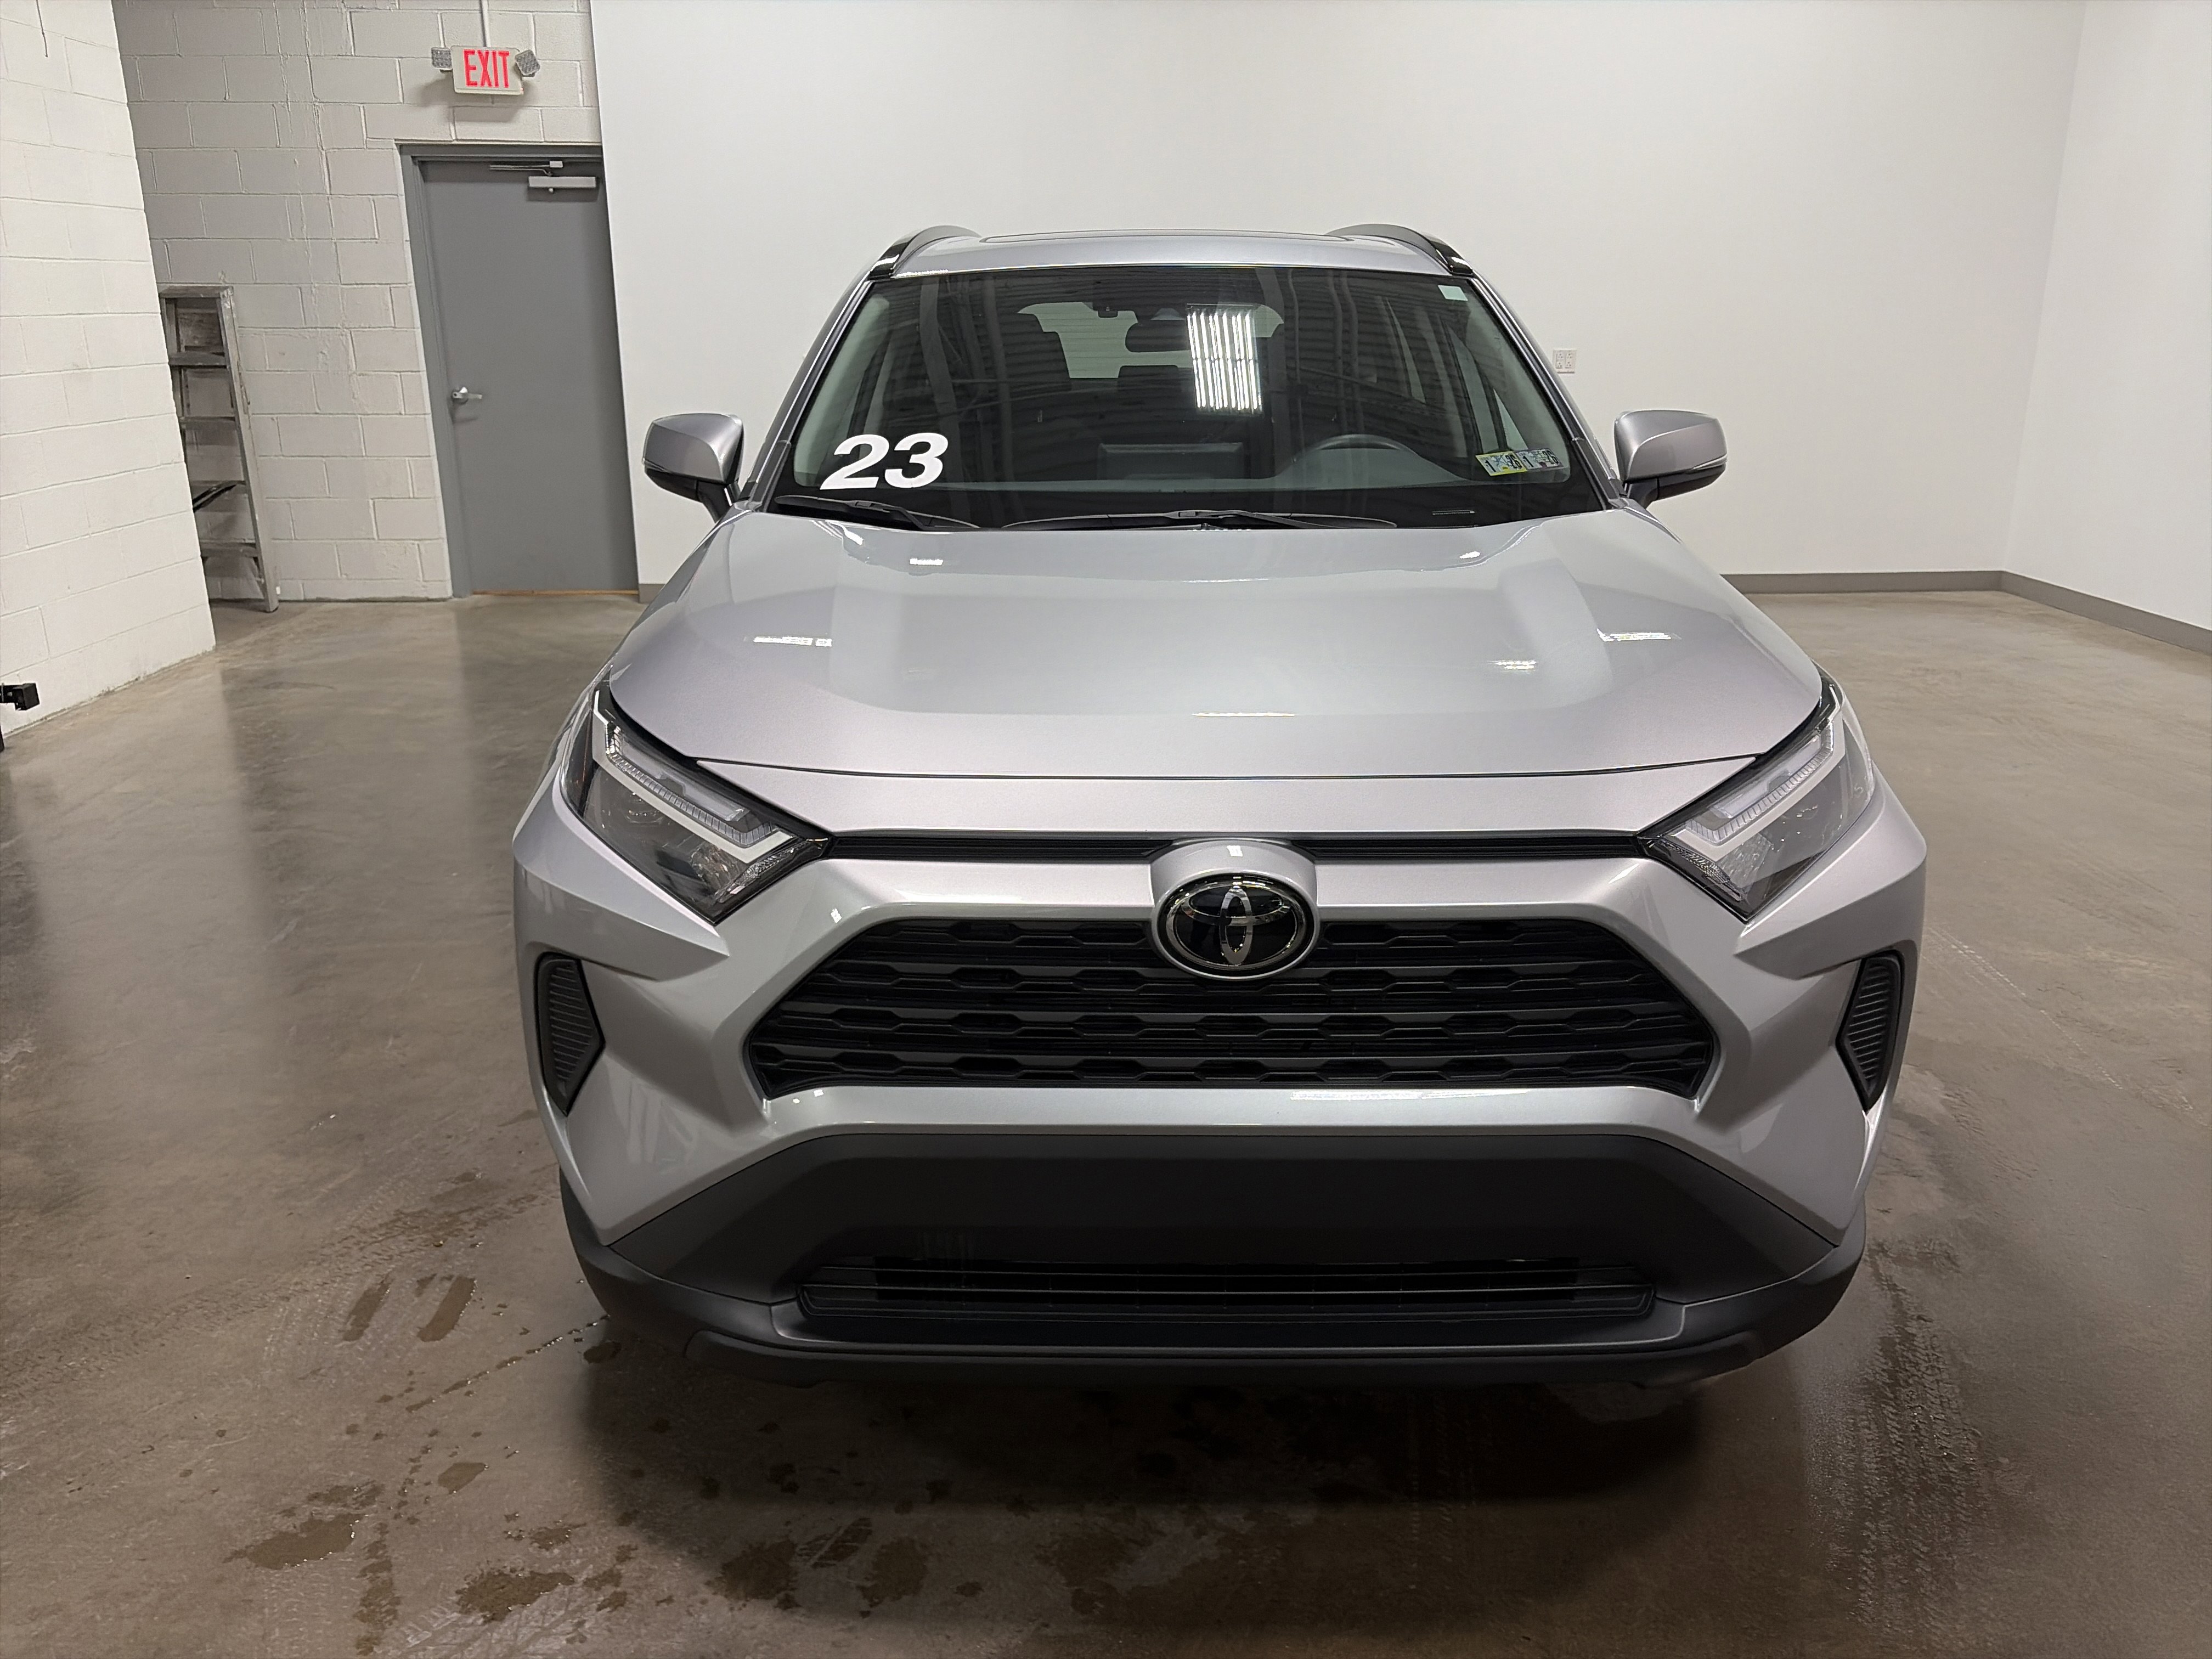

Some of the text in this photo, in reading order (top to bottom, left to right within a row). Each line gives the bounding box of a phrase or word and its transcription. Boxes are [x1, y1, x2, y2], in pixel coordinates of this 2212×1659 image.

[463, 49, 510, 88] EXIT
[820, 432, 949, 490] 23
[1485, 460, 1496, 472] 1
[1522, 450, 1559, 467] 1 26
